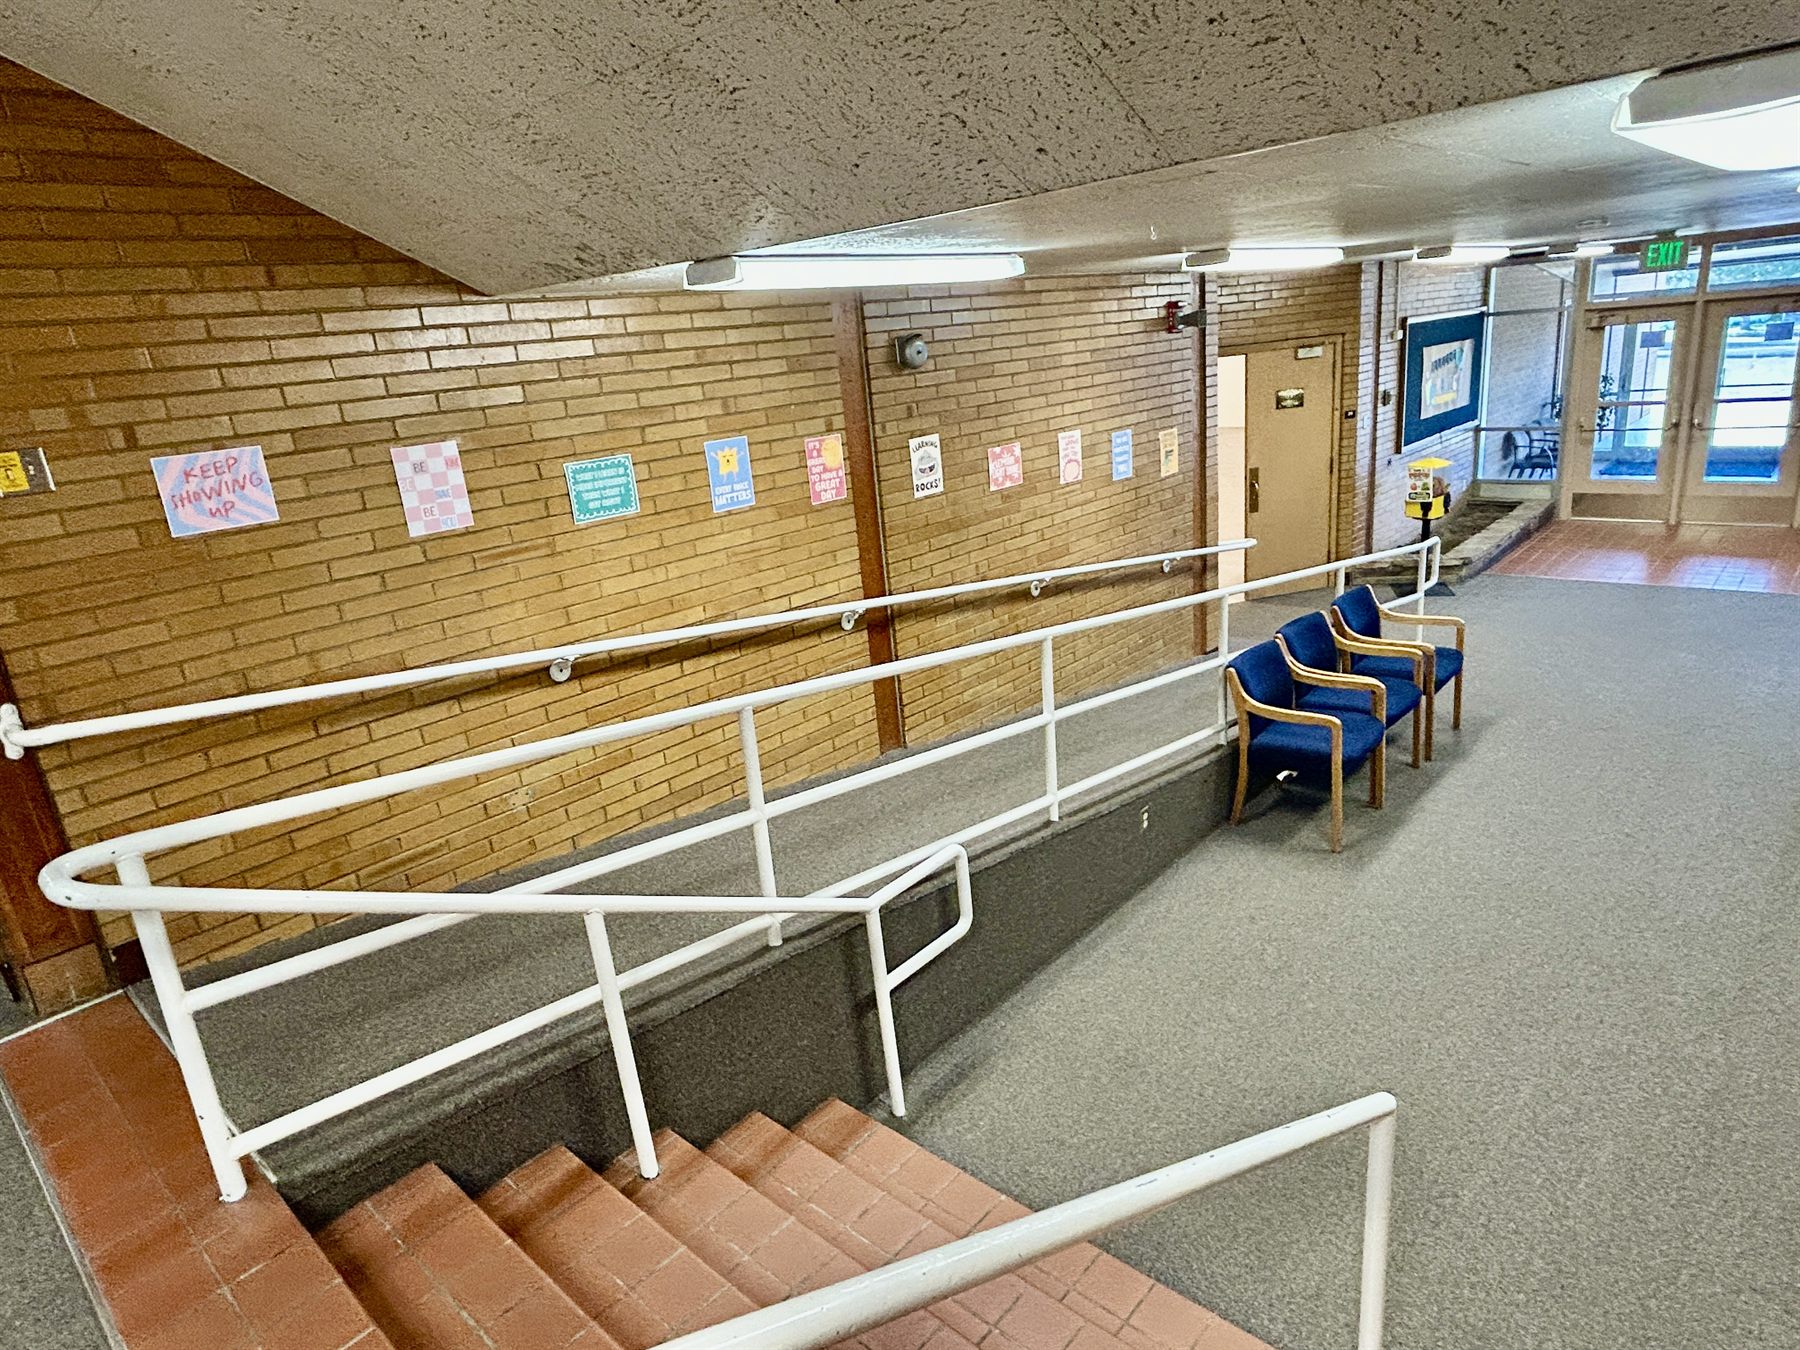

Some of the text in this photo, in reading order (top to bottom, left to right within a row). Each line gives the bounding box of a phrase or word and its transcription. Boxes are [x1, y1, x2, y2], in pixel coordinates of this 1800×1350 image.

[1647, 241, 1685, 267] EXIT
[183, 456, 238, 484] KEEP
[412, 461, 427, 473] BE
[171, 471, 264, 510] SHOWING
[815, 478, 841, 492] GREAT
[915, 478, 941, 492] ROCKS!
[714, 489, 752, 506] MATTERS
[820, 489, 837, 501] DAY
[208, 500, 236, 518] UP
[423, 506, 437, 518] BE
